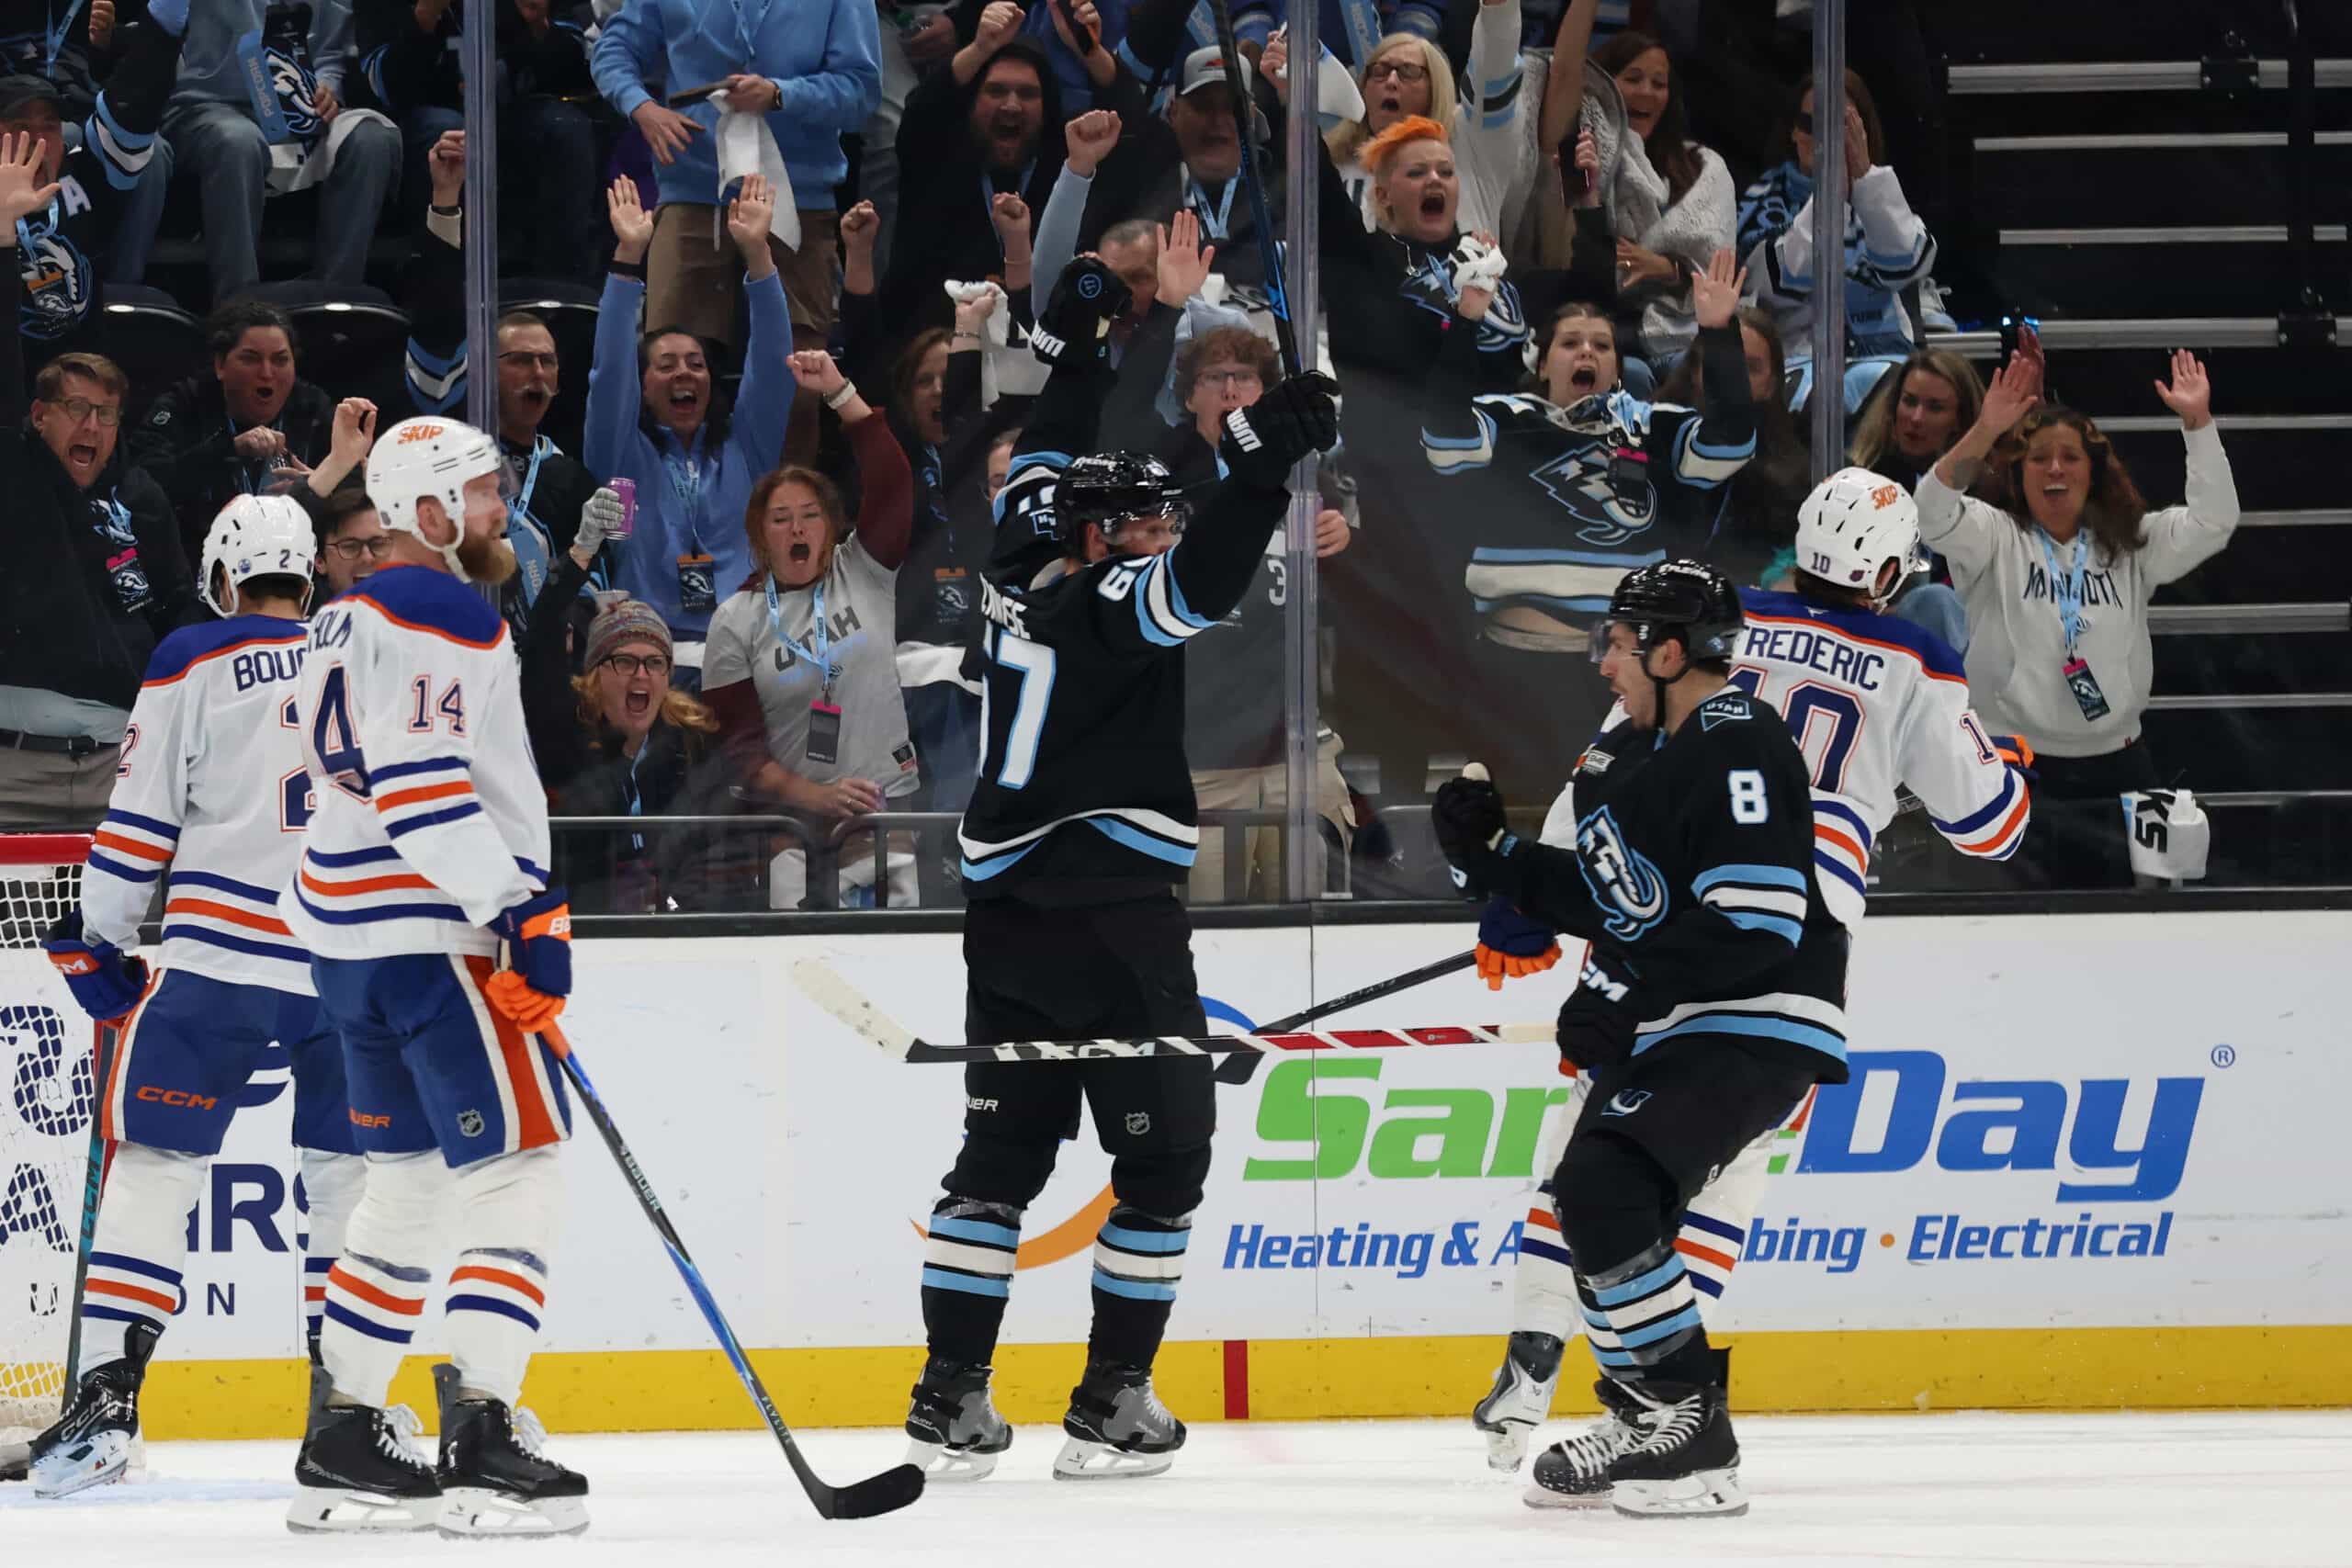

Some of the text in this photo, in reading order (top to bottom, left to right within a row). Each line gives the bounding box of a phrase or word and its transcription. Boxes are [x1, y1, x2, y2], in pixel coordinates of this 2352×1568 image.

[397, 425, 444, 445] SKIP
[1871, 484, 1898, 511] SKIP
[279, 549, 290, 569] 2
[1811, 552, 1831, 574] 10
[1745, 626, 1884, 691] REDERIC
[408, 674, 467, 739] 14
[979, 617, 1057, 790] 7
[1705, 701, 1745, 715] UTAH
[1727, 770, 1769, 824] 8
[136, 1087, 218, 1111] CCM
[1223, 1223, 1435, 1279] Heating
[1441, 1221, 1479, 1266] &
[1738, 1218, 1867, 1273] bing
[1906, 1212, 2174, 1260] Electrical
